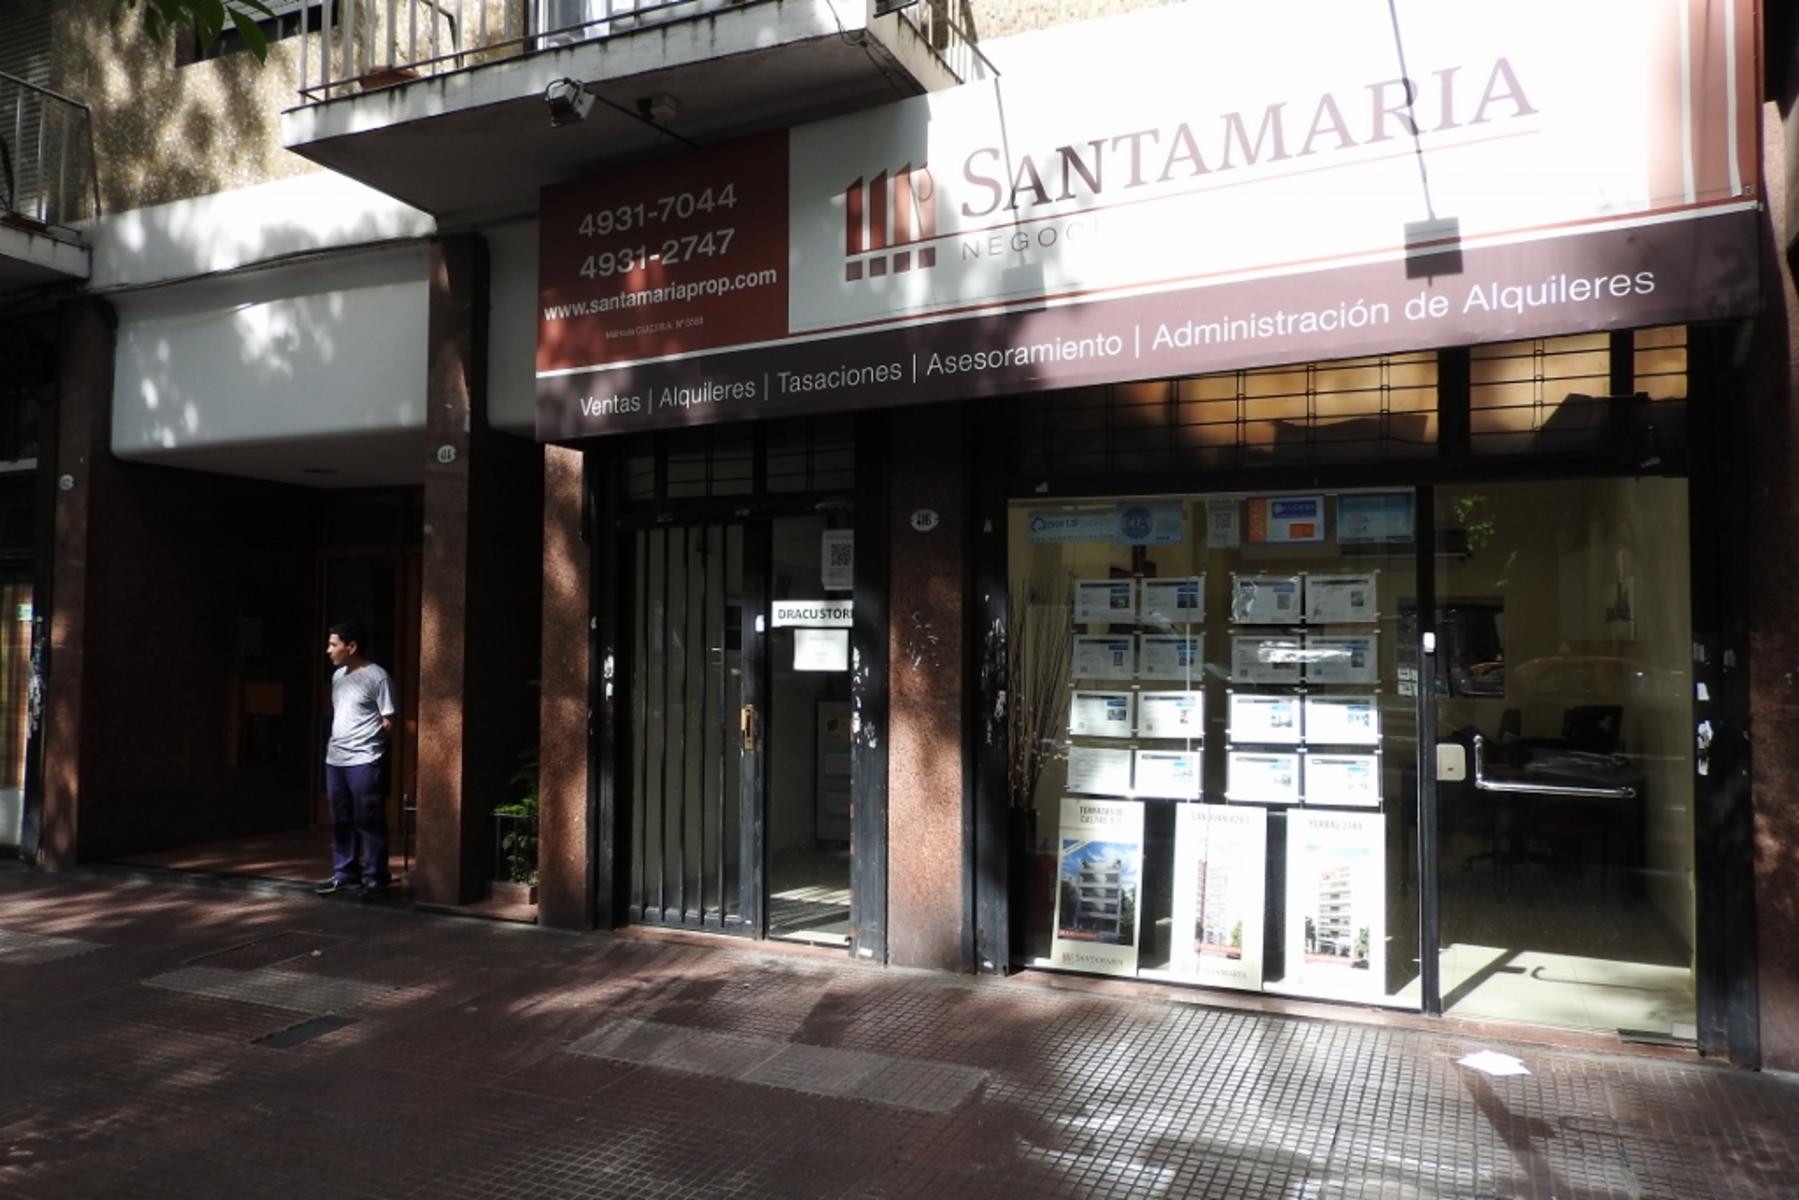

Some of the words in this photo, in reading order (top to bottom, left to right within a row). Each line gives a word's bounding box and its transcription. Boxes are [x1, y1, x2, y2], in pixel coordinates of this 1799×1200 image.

[960, 57, 1539, 217] SANTAMARIA
[578, 183, 737, 238] 4931-7044
[580, 228, 735, 278] 4931-2747
[544, 268, 777, 320] www.santamariaprop.com
[580, 395, 640, 417] Ventas
[659, 378, 756, 410] Alquileres
[777, 362, 903, 395] Tasaciones
[926, 331, 1122, 376] Asesoramiento
[1152, 298, 1391, 351] Administración
[1405, 290, 1449, 321] de
[1464, 268, 1656, 314] Alquileres
